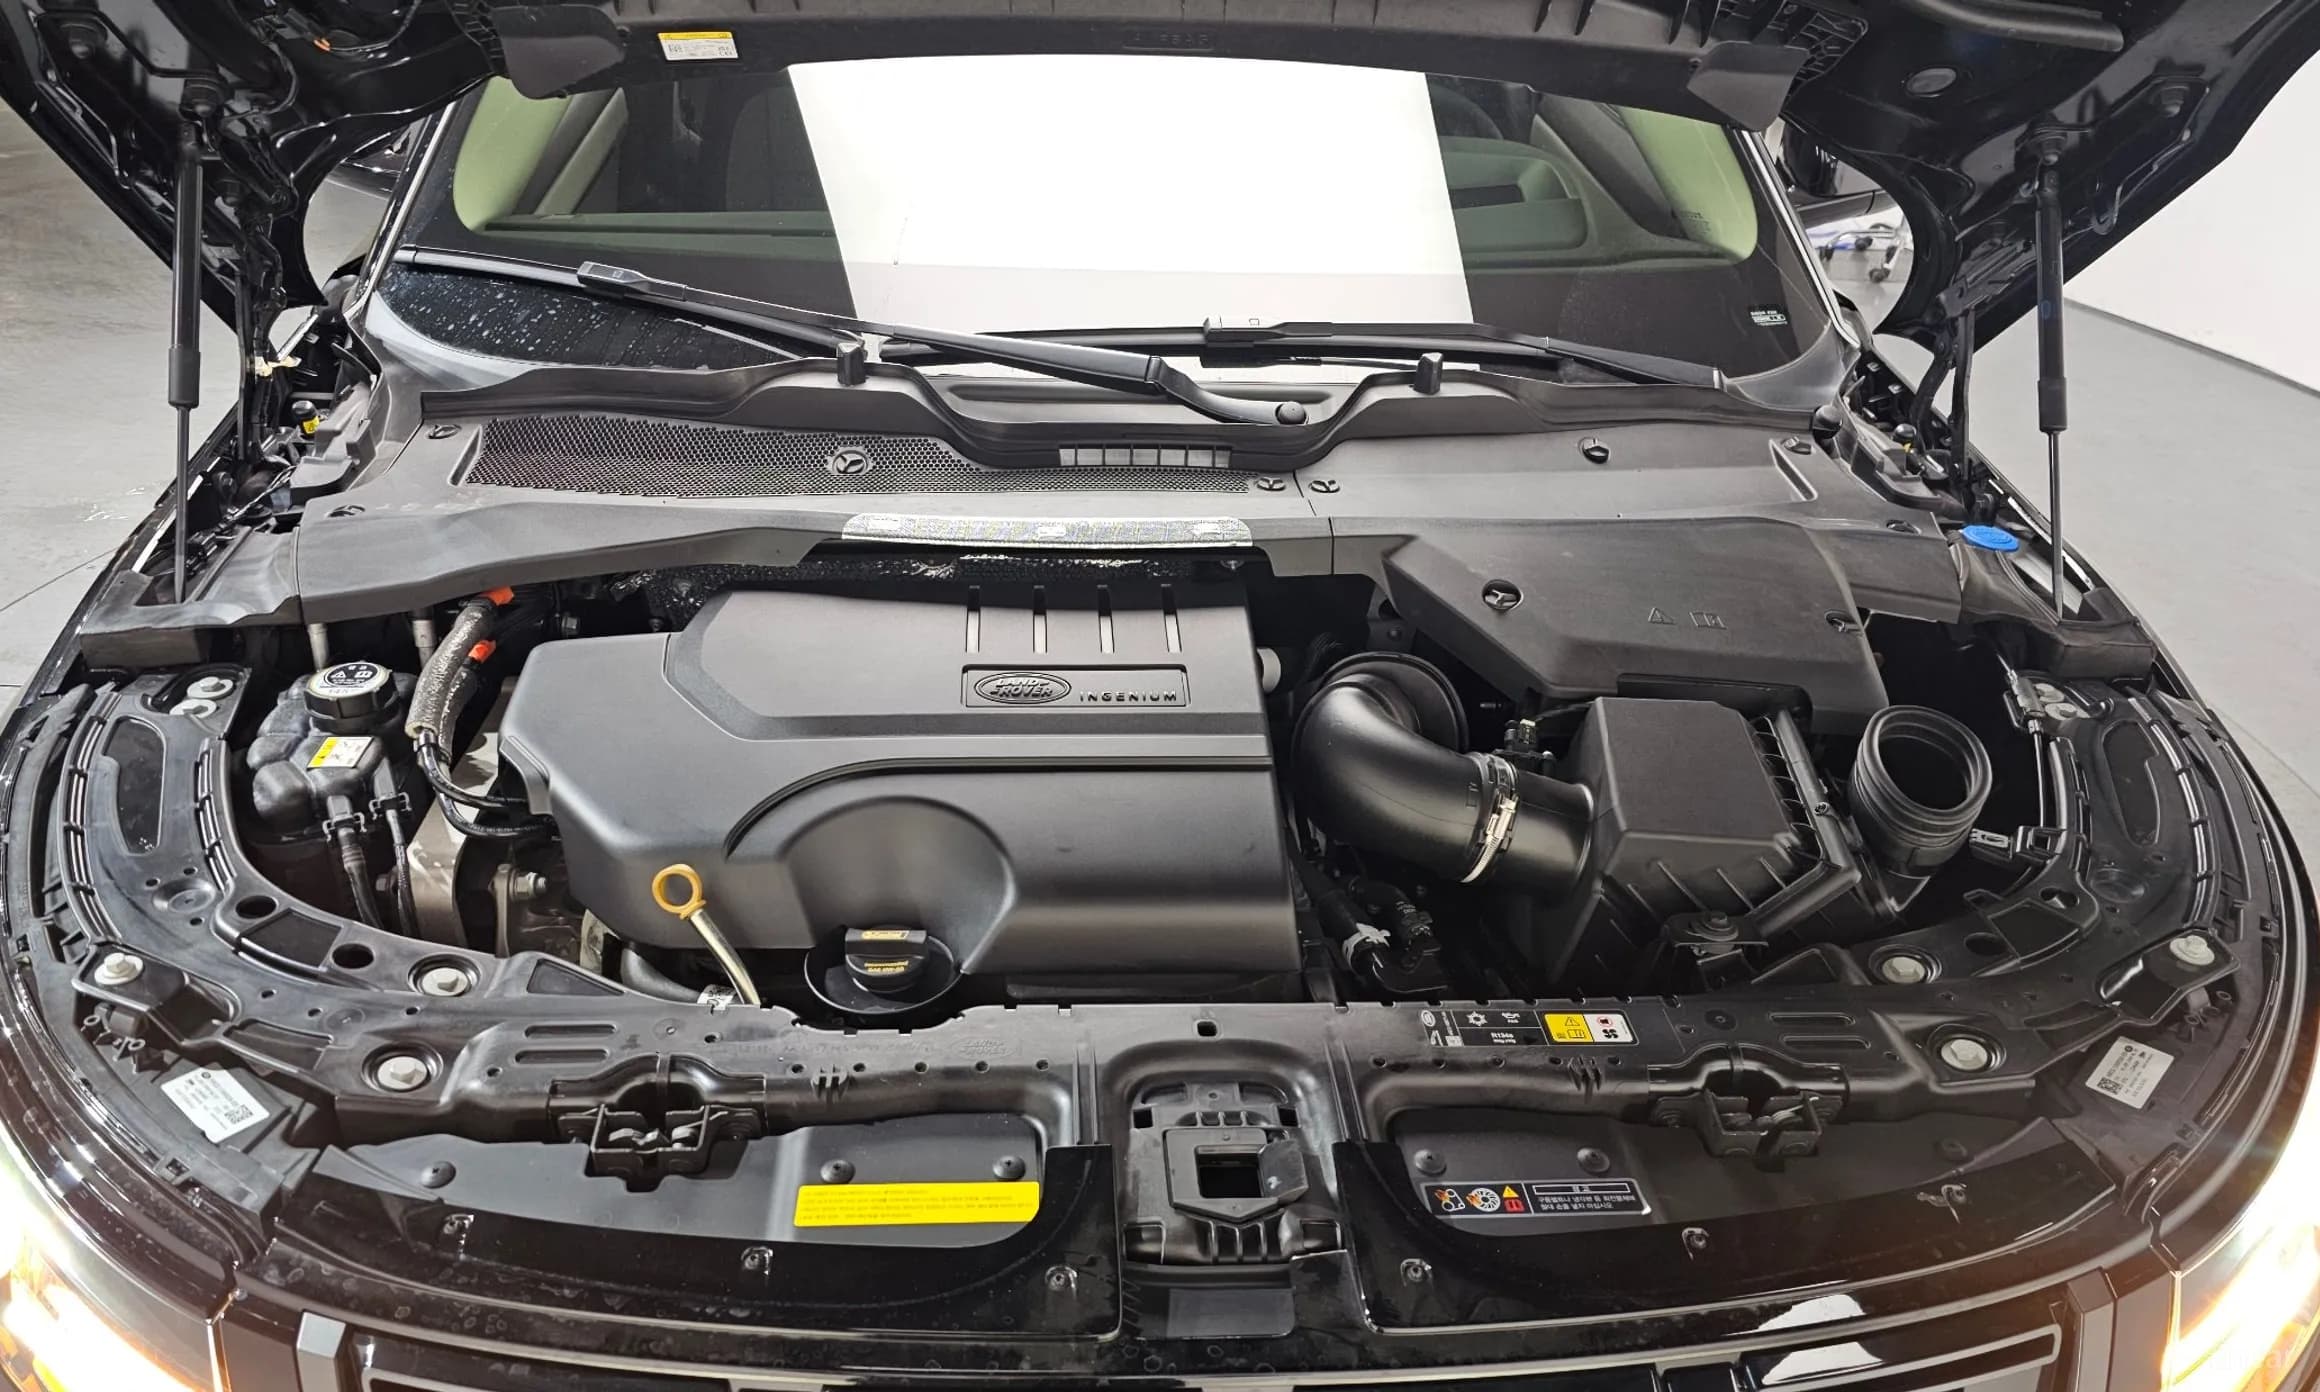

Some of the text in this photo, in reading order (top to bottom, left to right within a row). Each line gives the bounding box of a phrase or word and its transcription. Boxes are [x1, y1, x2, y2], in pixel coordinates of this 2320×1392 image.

[996, 677, 1050, 687] LAND
[990, 686, 1053, 698] ROVER
[1079, 691, 1177, 702] INGENIUM
